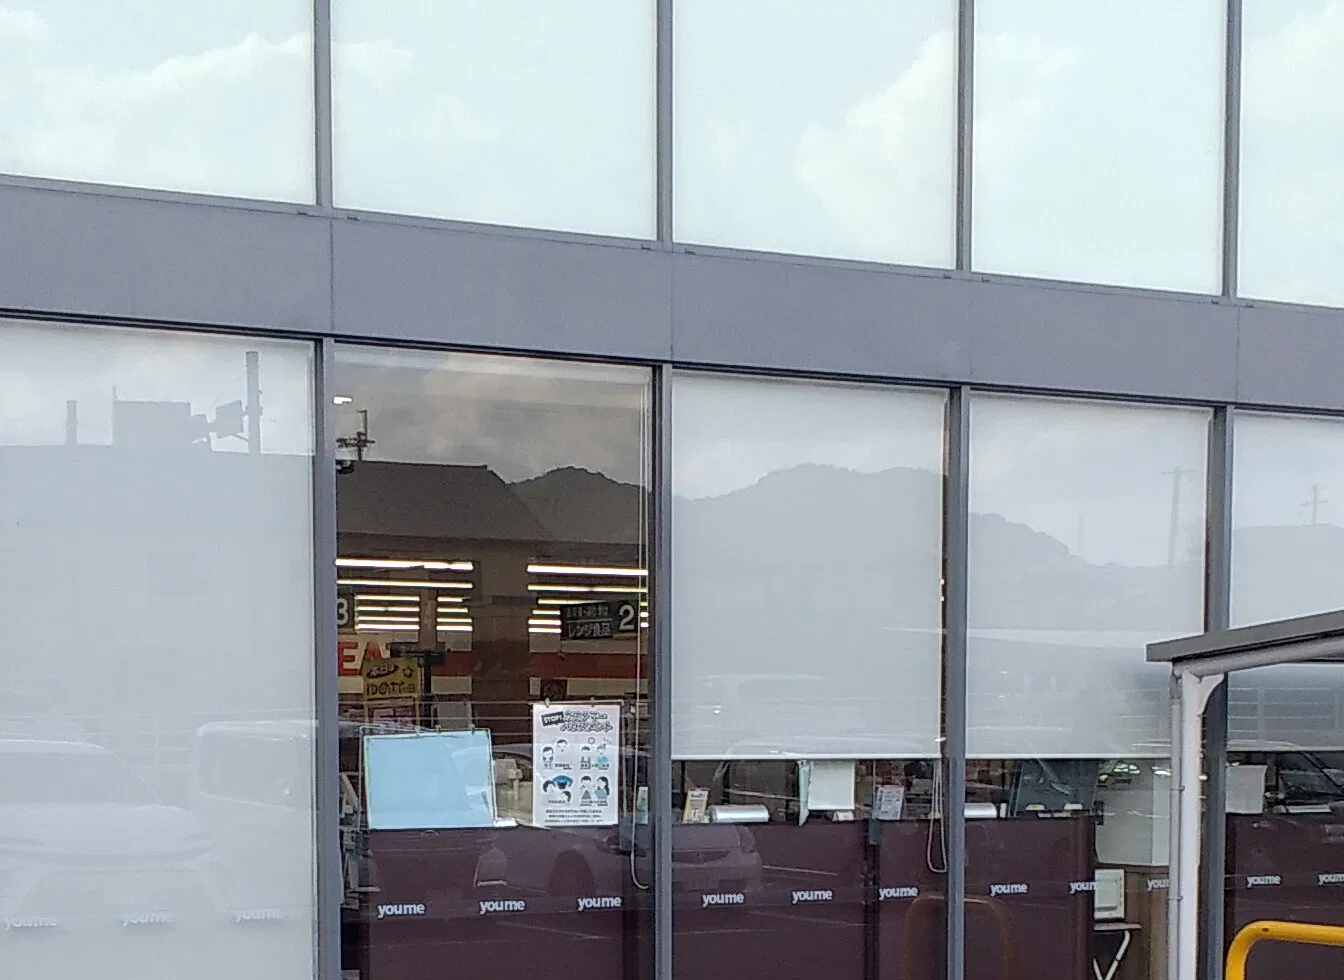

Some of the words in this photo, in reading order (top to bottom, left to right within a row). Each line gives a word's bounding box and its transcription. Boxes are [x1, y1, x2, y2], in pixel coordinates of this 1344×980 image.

[619, 604, 635, 631] 2
[567, 622, 612, 638] レンジ食品
[990, 881, 1029, 897] youme
[1246, 874, 1282, 889] youme
[703, 891, 745, 909] youme
[792, 887, 834, 905] youme
[879, 884, 918, 901] youme
[377, 901, 426, 920] youme
[479, 898, 526, 916] youme
[578, 894, 622, 912] youme
